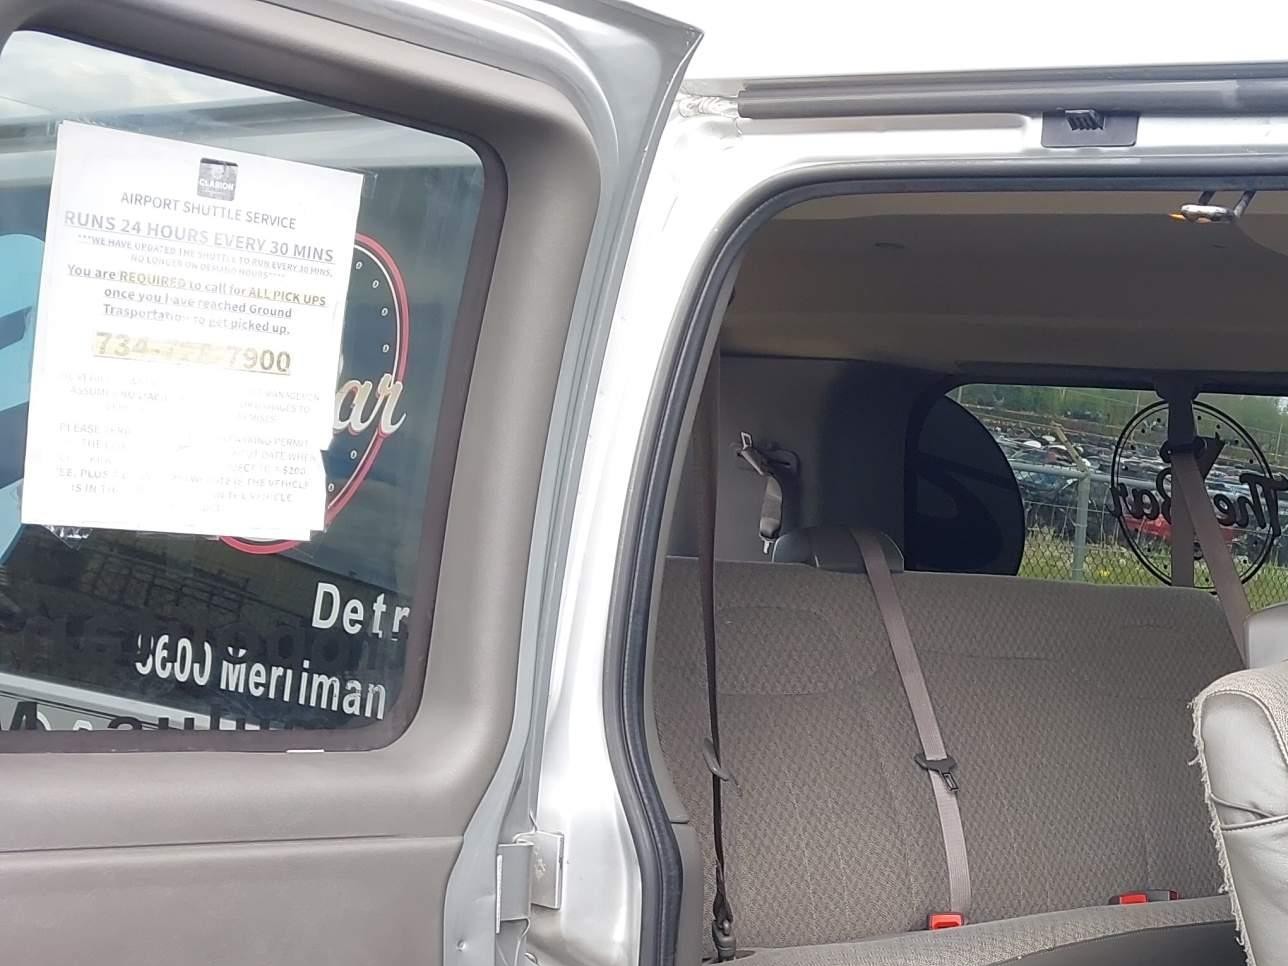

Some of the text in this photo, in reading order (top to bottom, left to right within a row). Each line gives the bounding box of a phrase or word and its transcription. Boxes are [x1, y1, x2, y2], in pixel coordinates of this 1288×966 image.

[120, 191, 180, 212] AIRPORT
[183, 200, 242, 222] SHUTTLE
[245, 210, 296, 230] SERVICE
[64, 210, 334, 262] RUNS 24 HOURS EVERY 30 MINS
[108, 238, 132, 249] HAVE
[134, 242, 176, 254] UPDATED
[179, 248, 195, 258] THE
[239, 256, 250, 264] TO
[251, 258, 270, 268] RUN
[271, 261, 297, 272] EVERY
[298, 265, 309, 273] 30
[130, 254, 145, 264] NO
[68, 264, 326, 306] You are REQUIRED to call for ALL PICK UPS
[104, 288, 292, 318] once you have reached Ground
[231, 319, 269, 332] picked
[272, 325, 290, 336] up.
